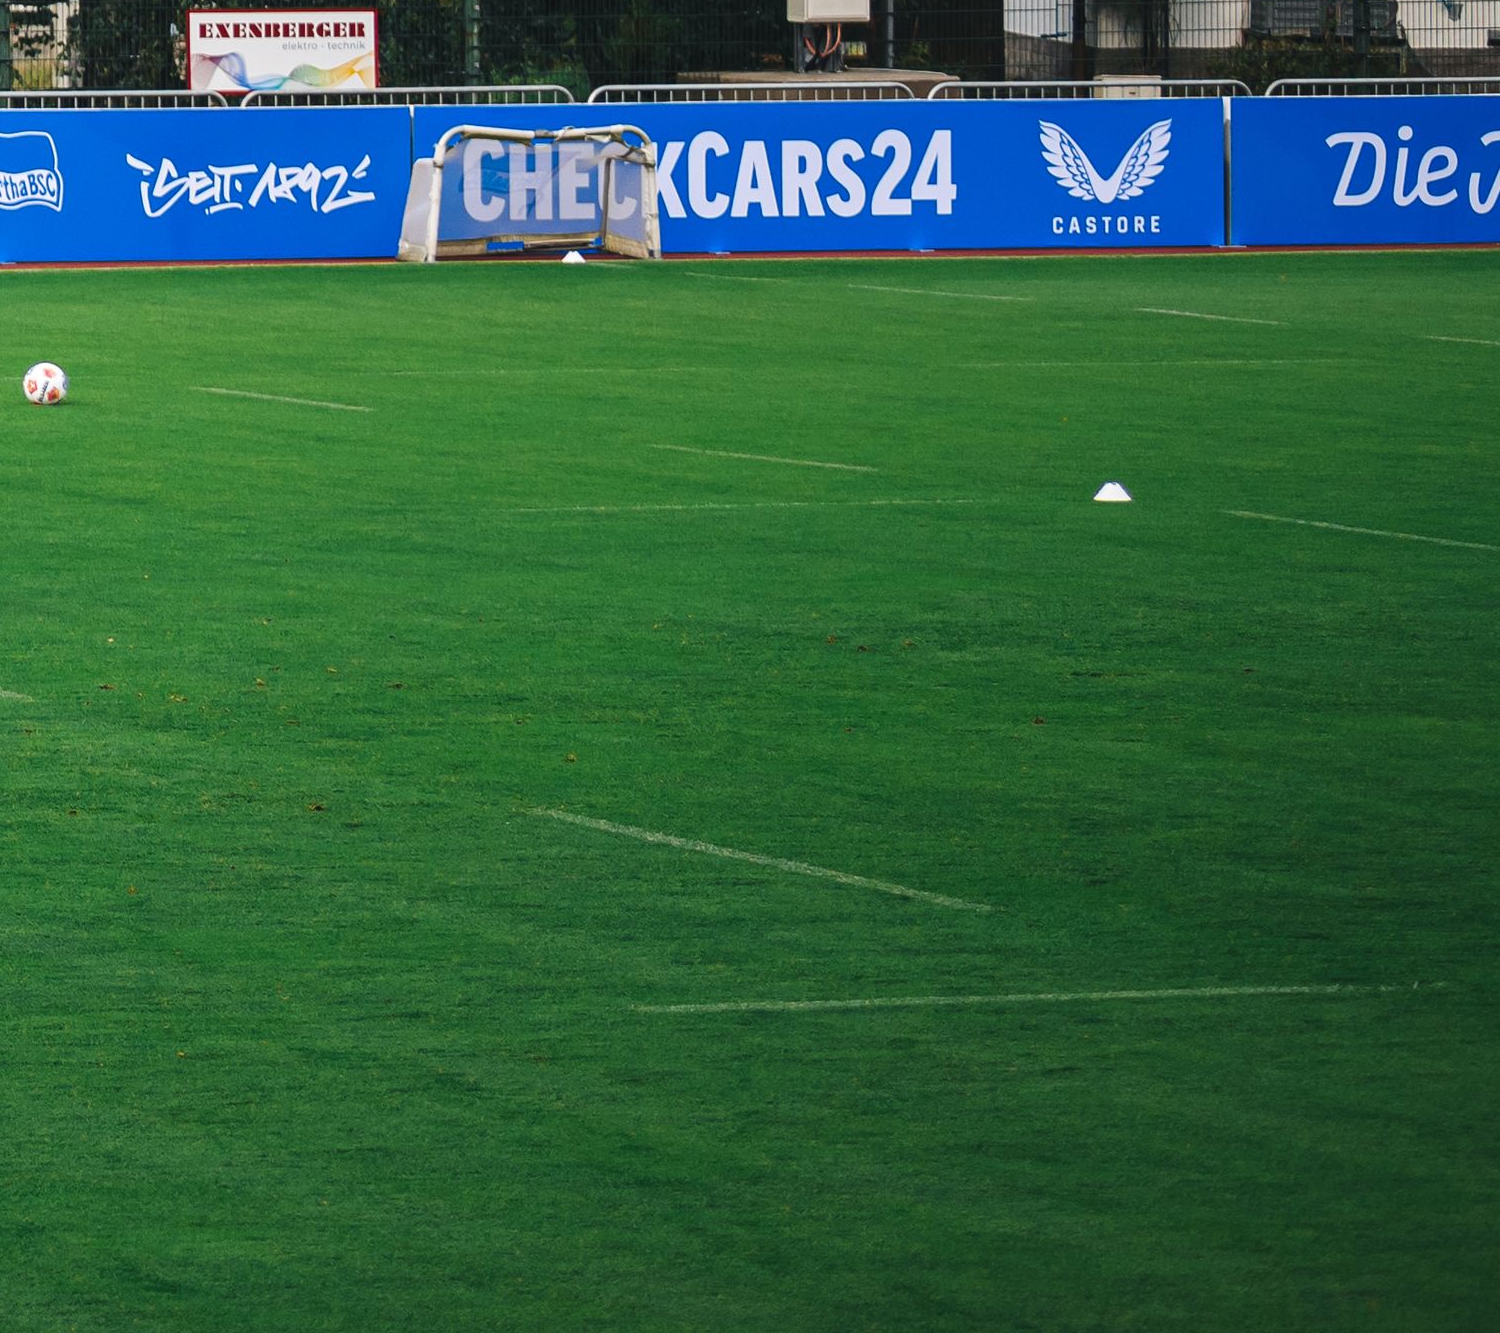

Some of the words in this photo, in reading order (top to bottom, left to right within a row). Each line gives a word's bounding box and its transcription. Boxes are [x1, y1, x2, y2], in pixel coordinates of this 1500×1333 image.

[199, 22, 366, 39] EXENBERGER
[282, 40, 318, 51] elektro
[327, 40, 366, 51] technik
[1324, 125, 1458, 207] Die
[247, 161, 376, 215] 1892
[1051, 216, 1161, 234] CASTORE
